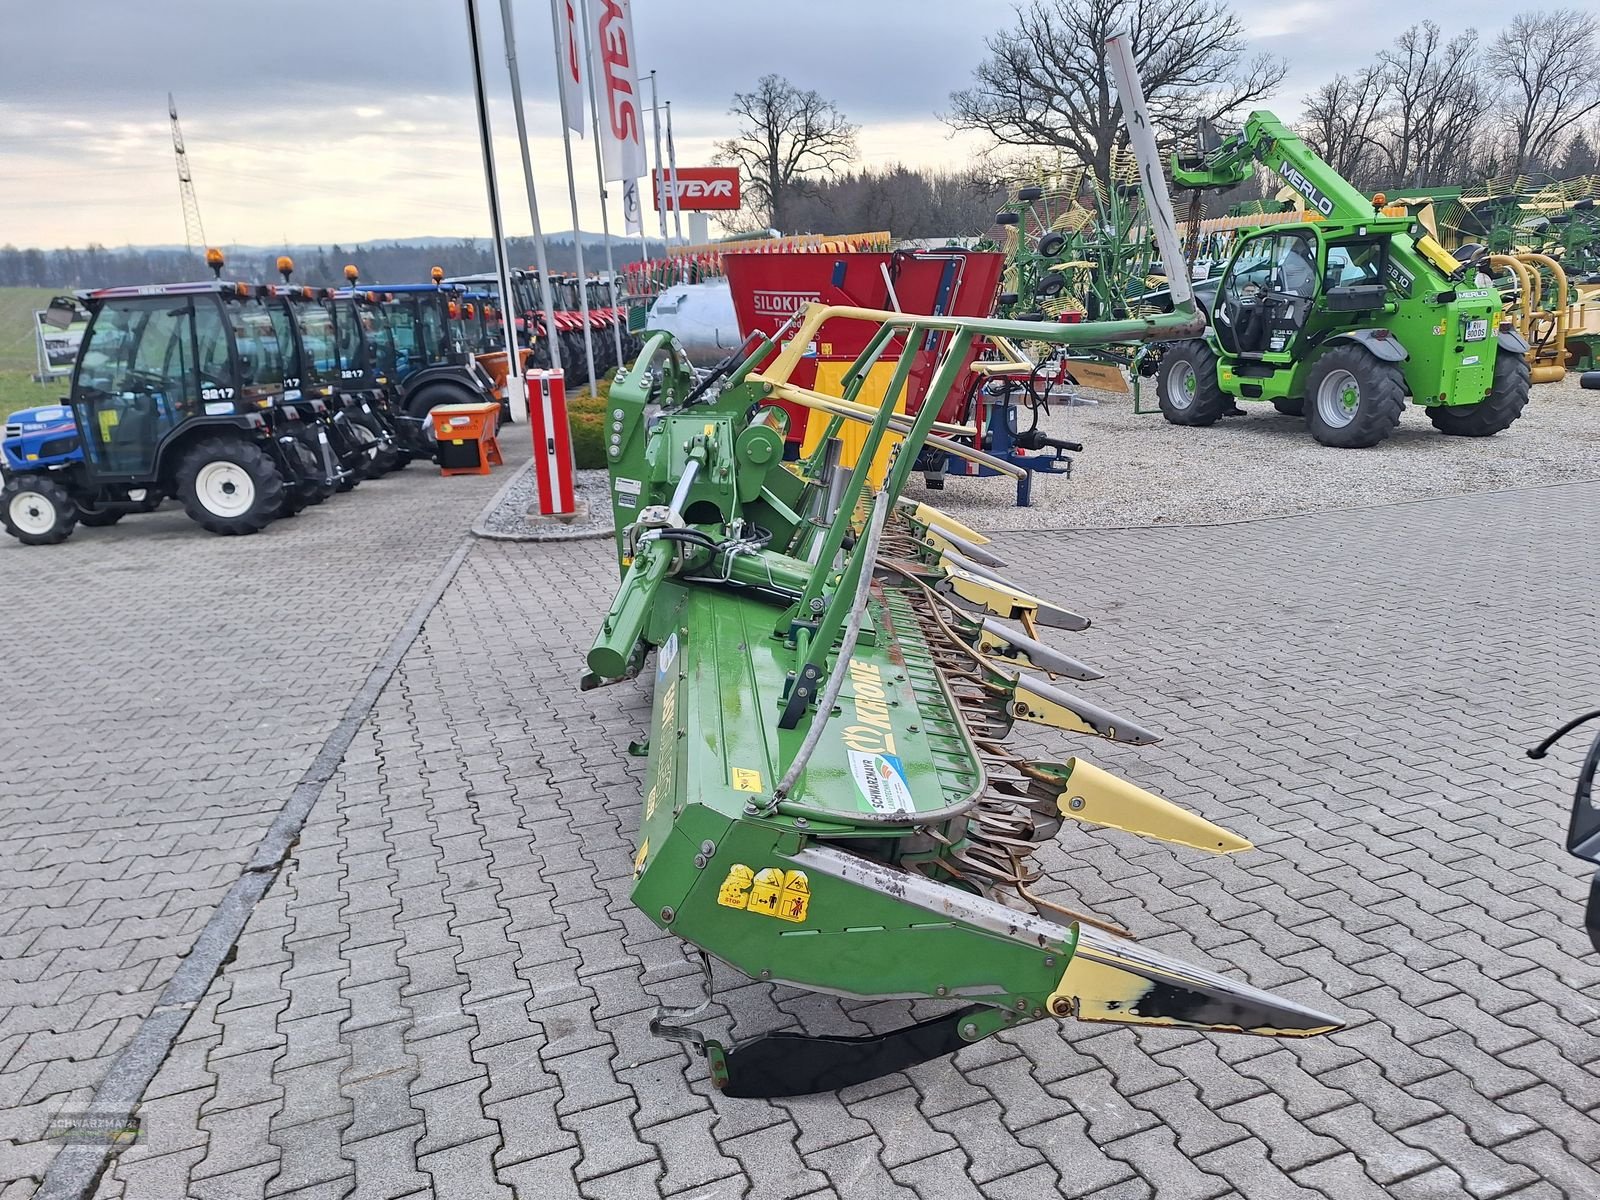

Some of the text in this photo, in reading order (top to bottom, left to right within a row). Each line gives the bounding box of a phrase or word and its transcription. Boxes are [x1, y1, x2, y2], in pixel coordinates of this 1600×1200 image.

[1280, 161, 1333, 215] MERLO
[1387, 263, 1409, 288] 38.10
[753, 295, 820, 311] SILOKI
[1458, 290, 1488, 300] MERLO
[202, 387, 235, 400] 3217
[849, 658, 892, 731] KRONE
[863, 759, 885, 809] SCHWARZMAYR
[724, 897, 741, 905] STOP
